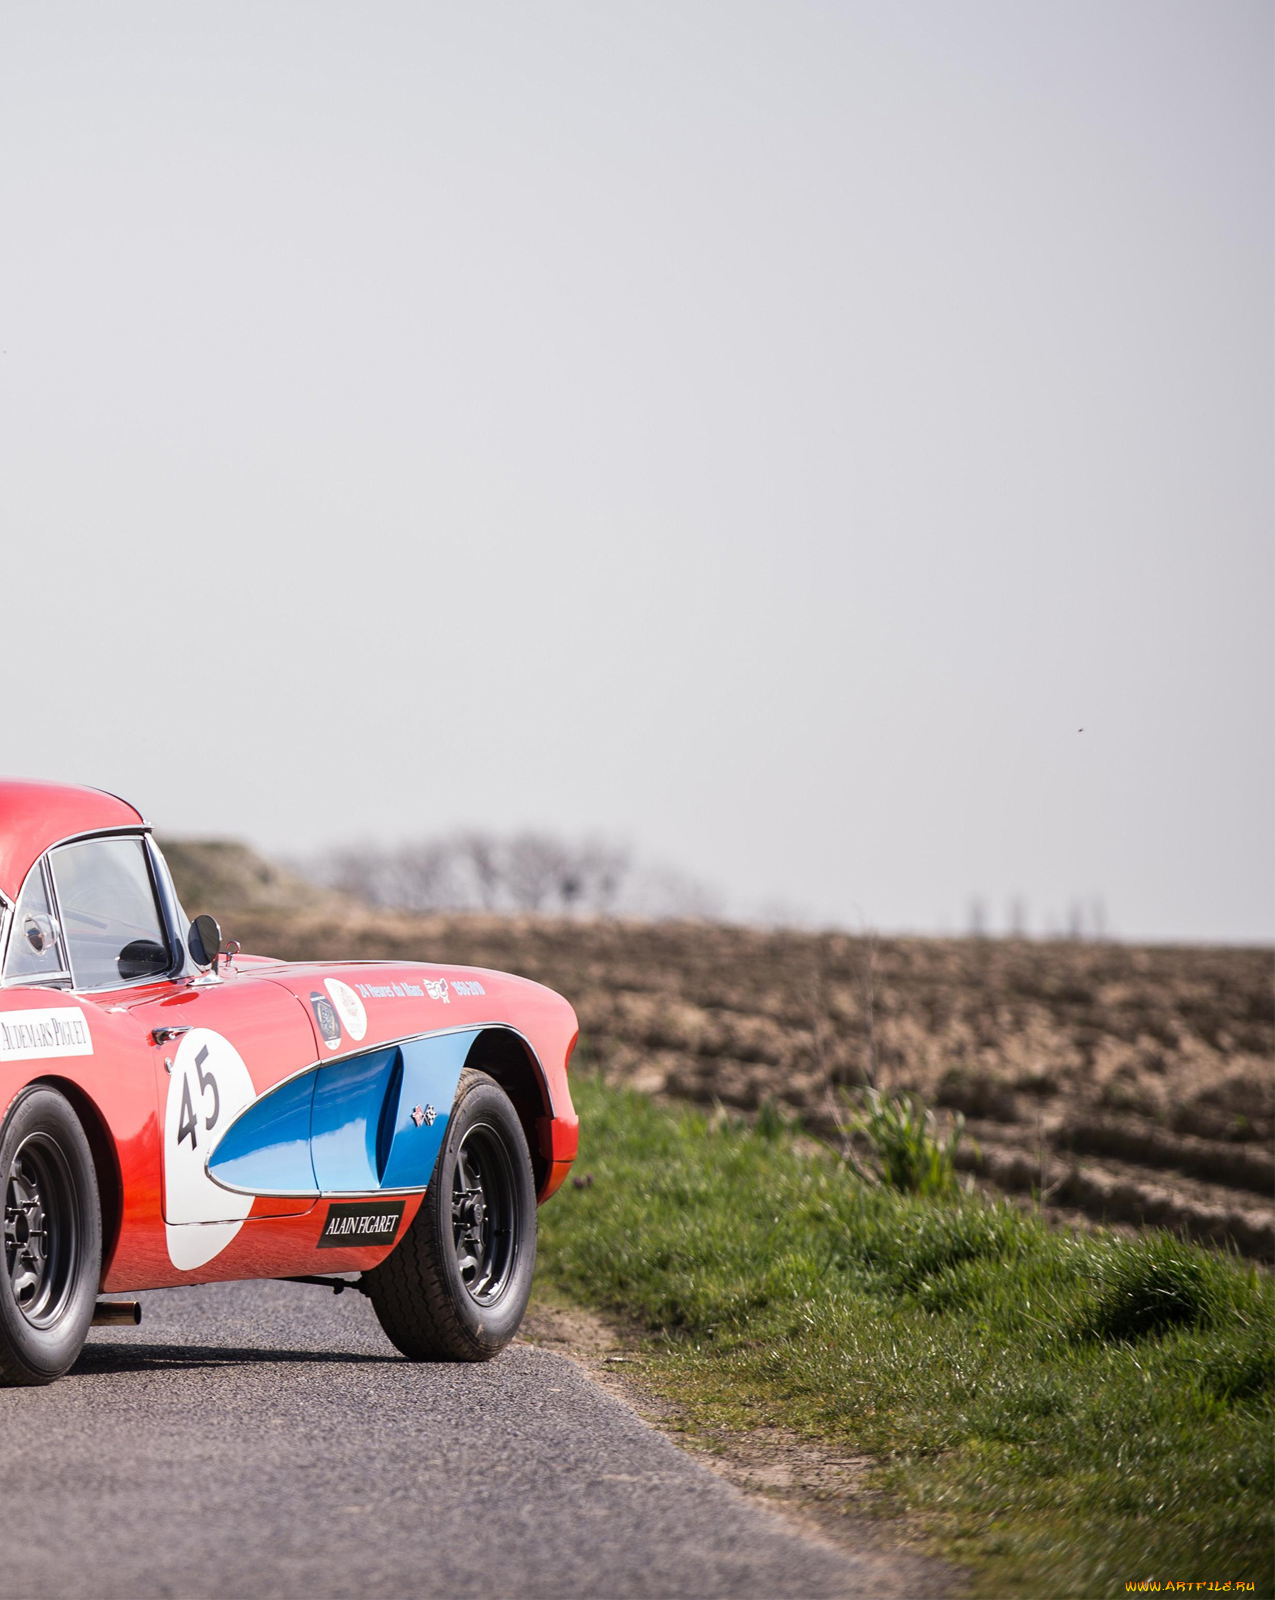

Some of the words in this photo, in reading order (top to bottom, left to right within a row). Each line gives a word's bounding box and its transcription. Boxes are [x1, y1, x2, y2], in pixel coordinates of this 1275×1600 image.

[354, 984, 371, 998] 24
[365, 984, 395, 998] Heures
[390, 982, 405, 997] du
[400, 982, 424, 997] Mans
[0, 1022, 54, 1050] AUDEMARS
[50, 1018, 86, 1046] PIGUET
[177, 1044, 220, 1151] 45
[325, 1216, 359, 1235] ALAIN
[356, 1214, 399, 1234] FIGARET
